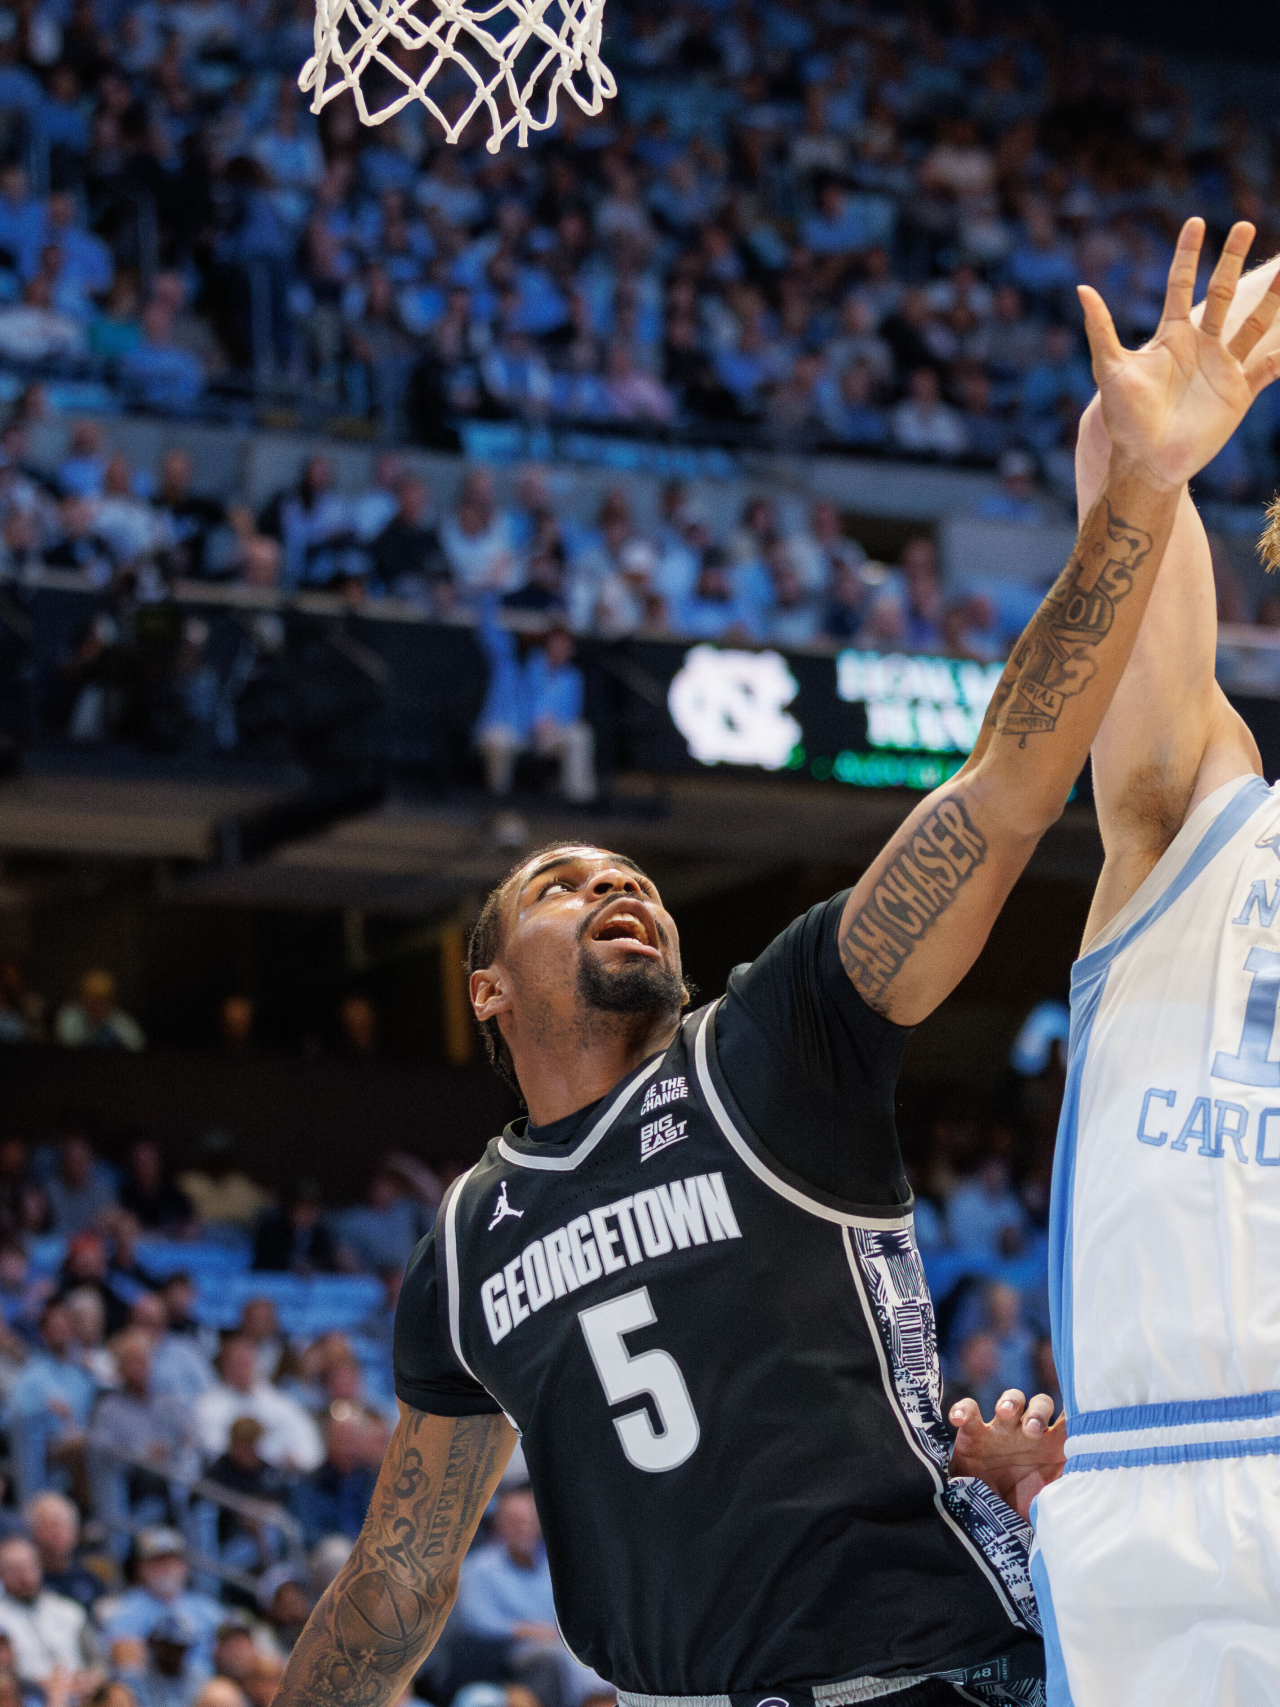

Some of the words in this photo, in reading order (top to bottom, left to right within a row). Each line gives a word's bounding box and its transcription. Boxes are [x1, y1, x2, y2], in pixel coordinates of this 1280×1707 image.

[881, 799, 988, 938] CHASER
[640, 1087, 689, 1116] CHANGE
[643, 1083, 657, 1103] BE
[660, 1076, 686, 1093] THE
[640, 1113, 673, 1142] BIG
[640, 1120, 688, 1155] EAST
[480, 1171, 743, 1346] GEORGETOWN
[577, 1285, 701, 1474] 5
[972, 1667, 992, 1680] 48
